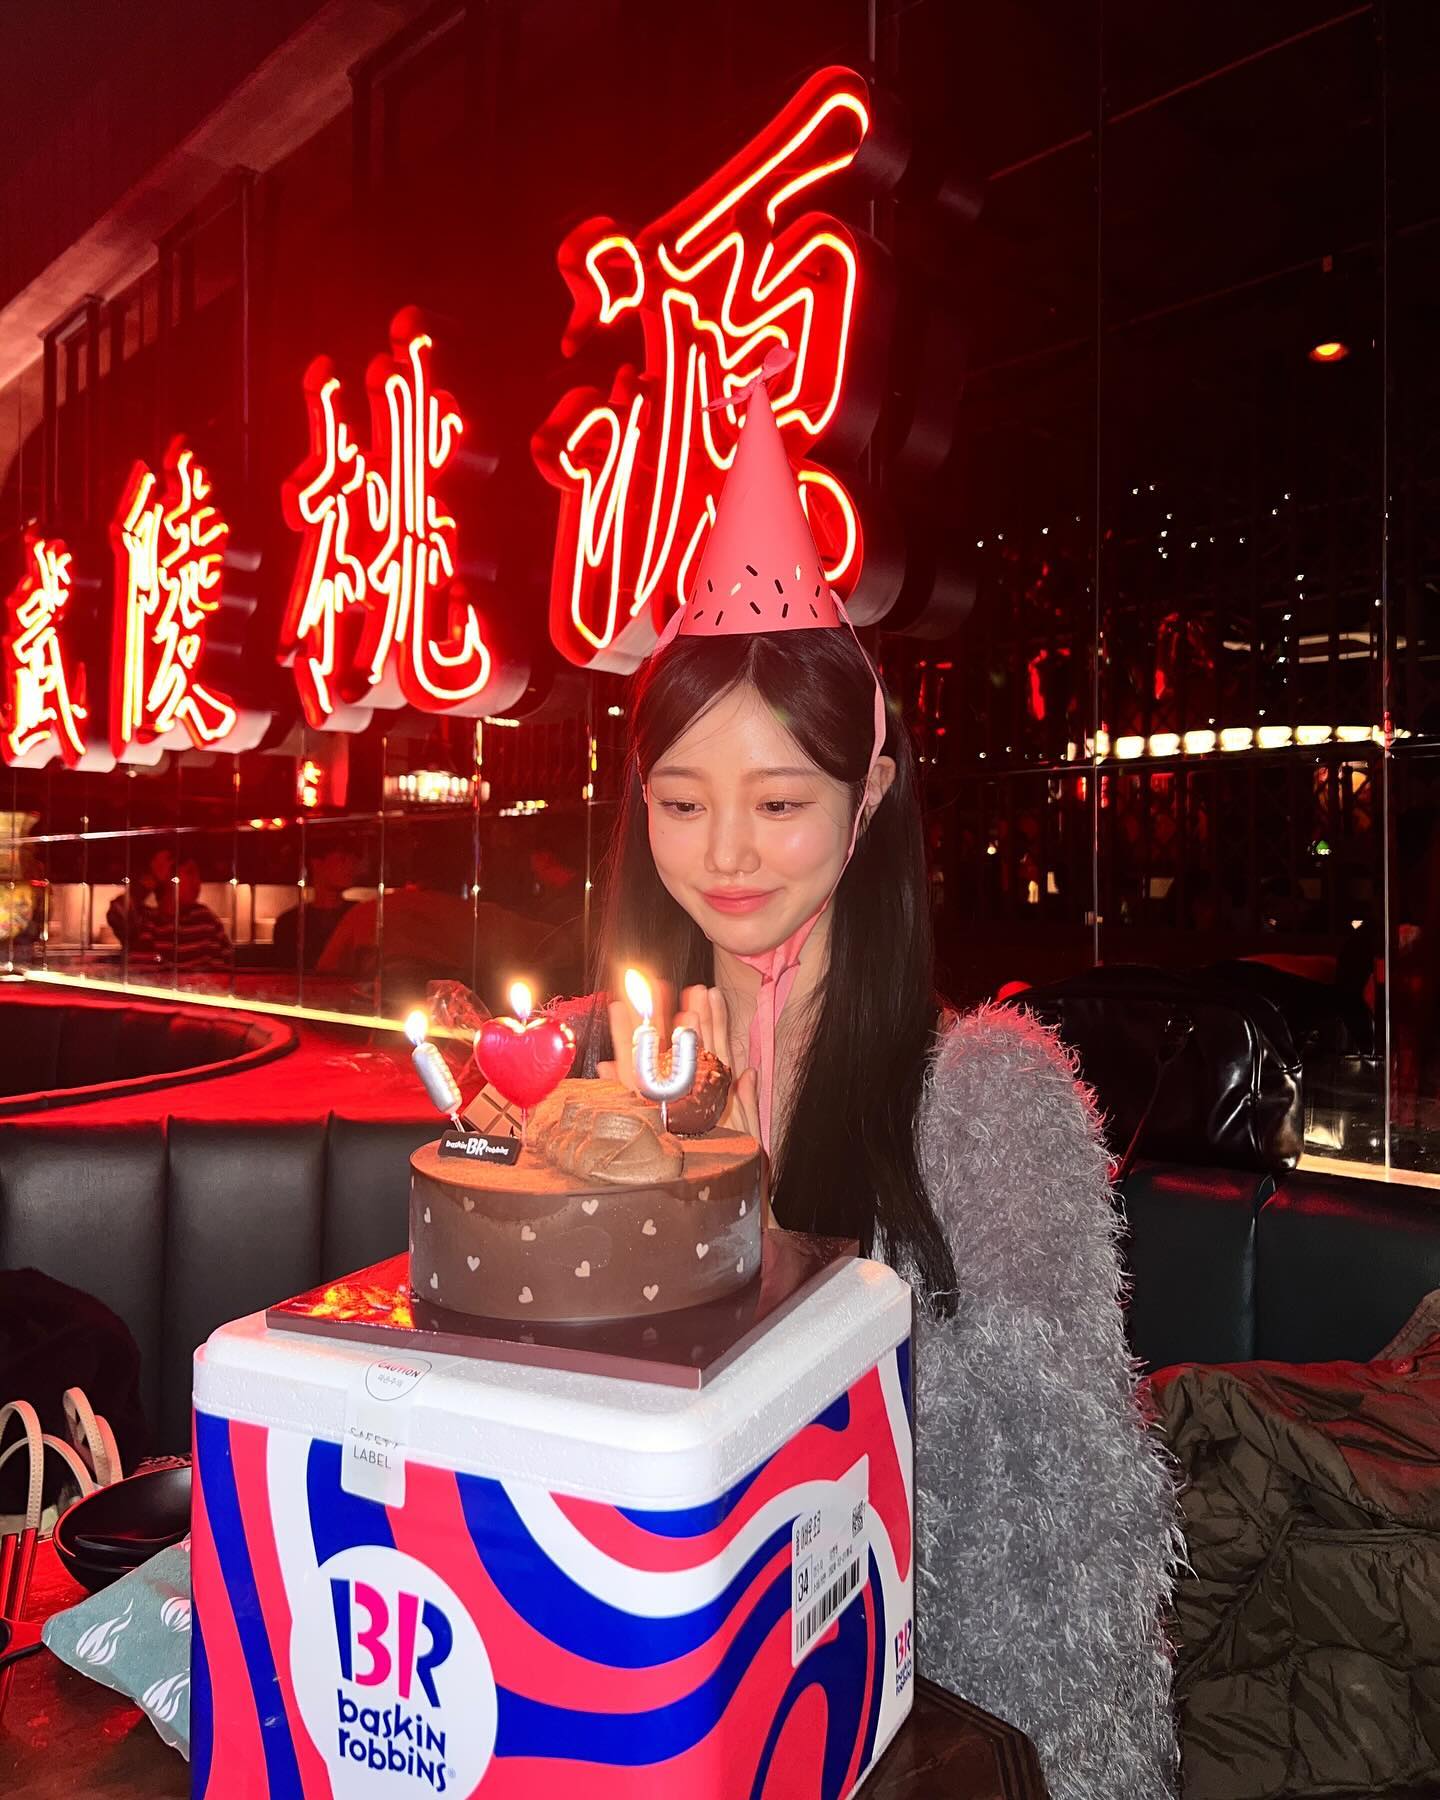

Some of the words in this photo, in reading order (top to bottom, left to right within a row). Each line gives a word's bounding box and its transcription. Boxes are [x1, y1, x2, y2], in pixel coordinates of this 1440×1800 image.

[466, 1137, 488, 1156] BR
[378, 1362, 421, 1378] CAUTION
[353, 1445, 392, 1470] LABEL
[798, 1567, 809, 1602] 34
[330, 1578, 453, 1708] BR
